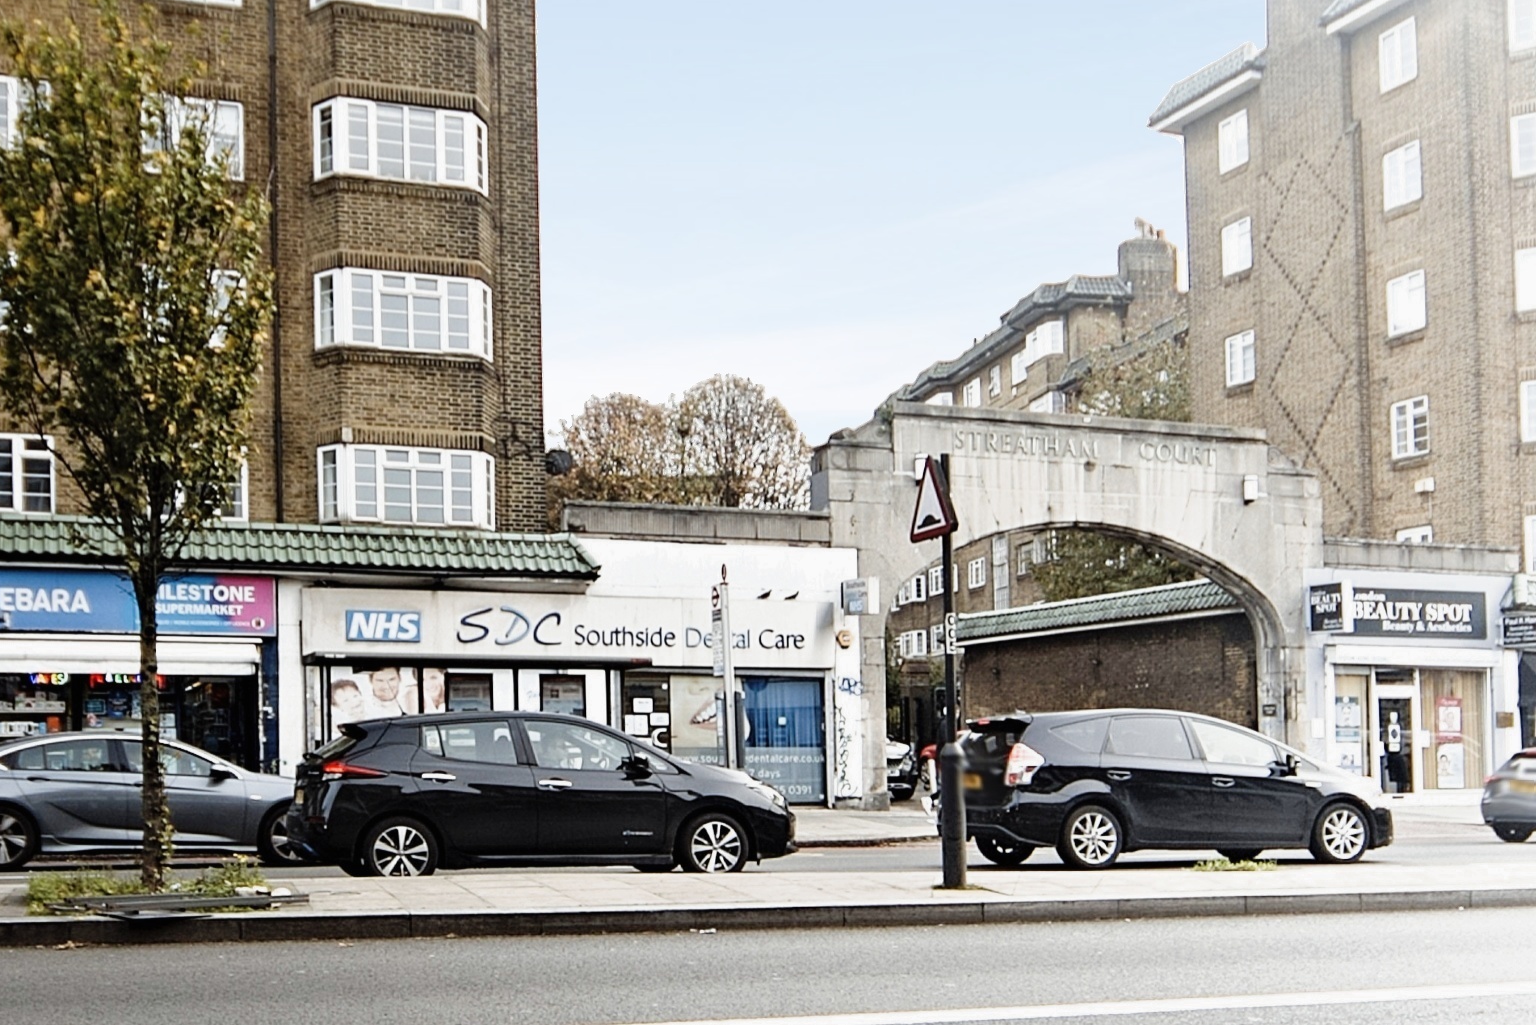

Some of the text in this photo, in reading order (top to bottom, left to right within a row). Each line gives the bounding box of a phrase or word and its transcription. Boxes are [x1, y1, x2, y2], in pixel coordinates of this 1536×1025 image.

[953, 429, 1217, 467] STREATHAM COURT
[156, 603, 243, 616] SUPERMARKET
[1353, 600, 1473, 622] BEAUTY SPOT
[348, 612, 420, 641] NHS
[457, 605, 562, 646] SDC
[574, 625, 676, 648] Southside
[759, 629, 805, 650] Care
[757, 768, 781, 779] days
[787, 784, 813, 795] 0391
